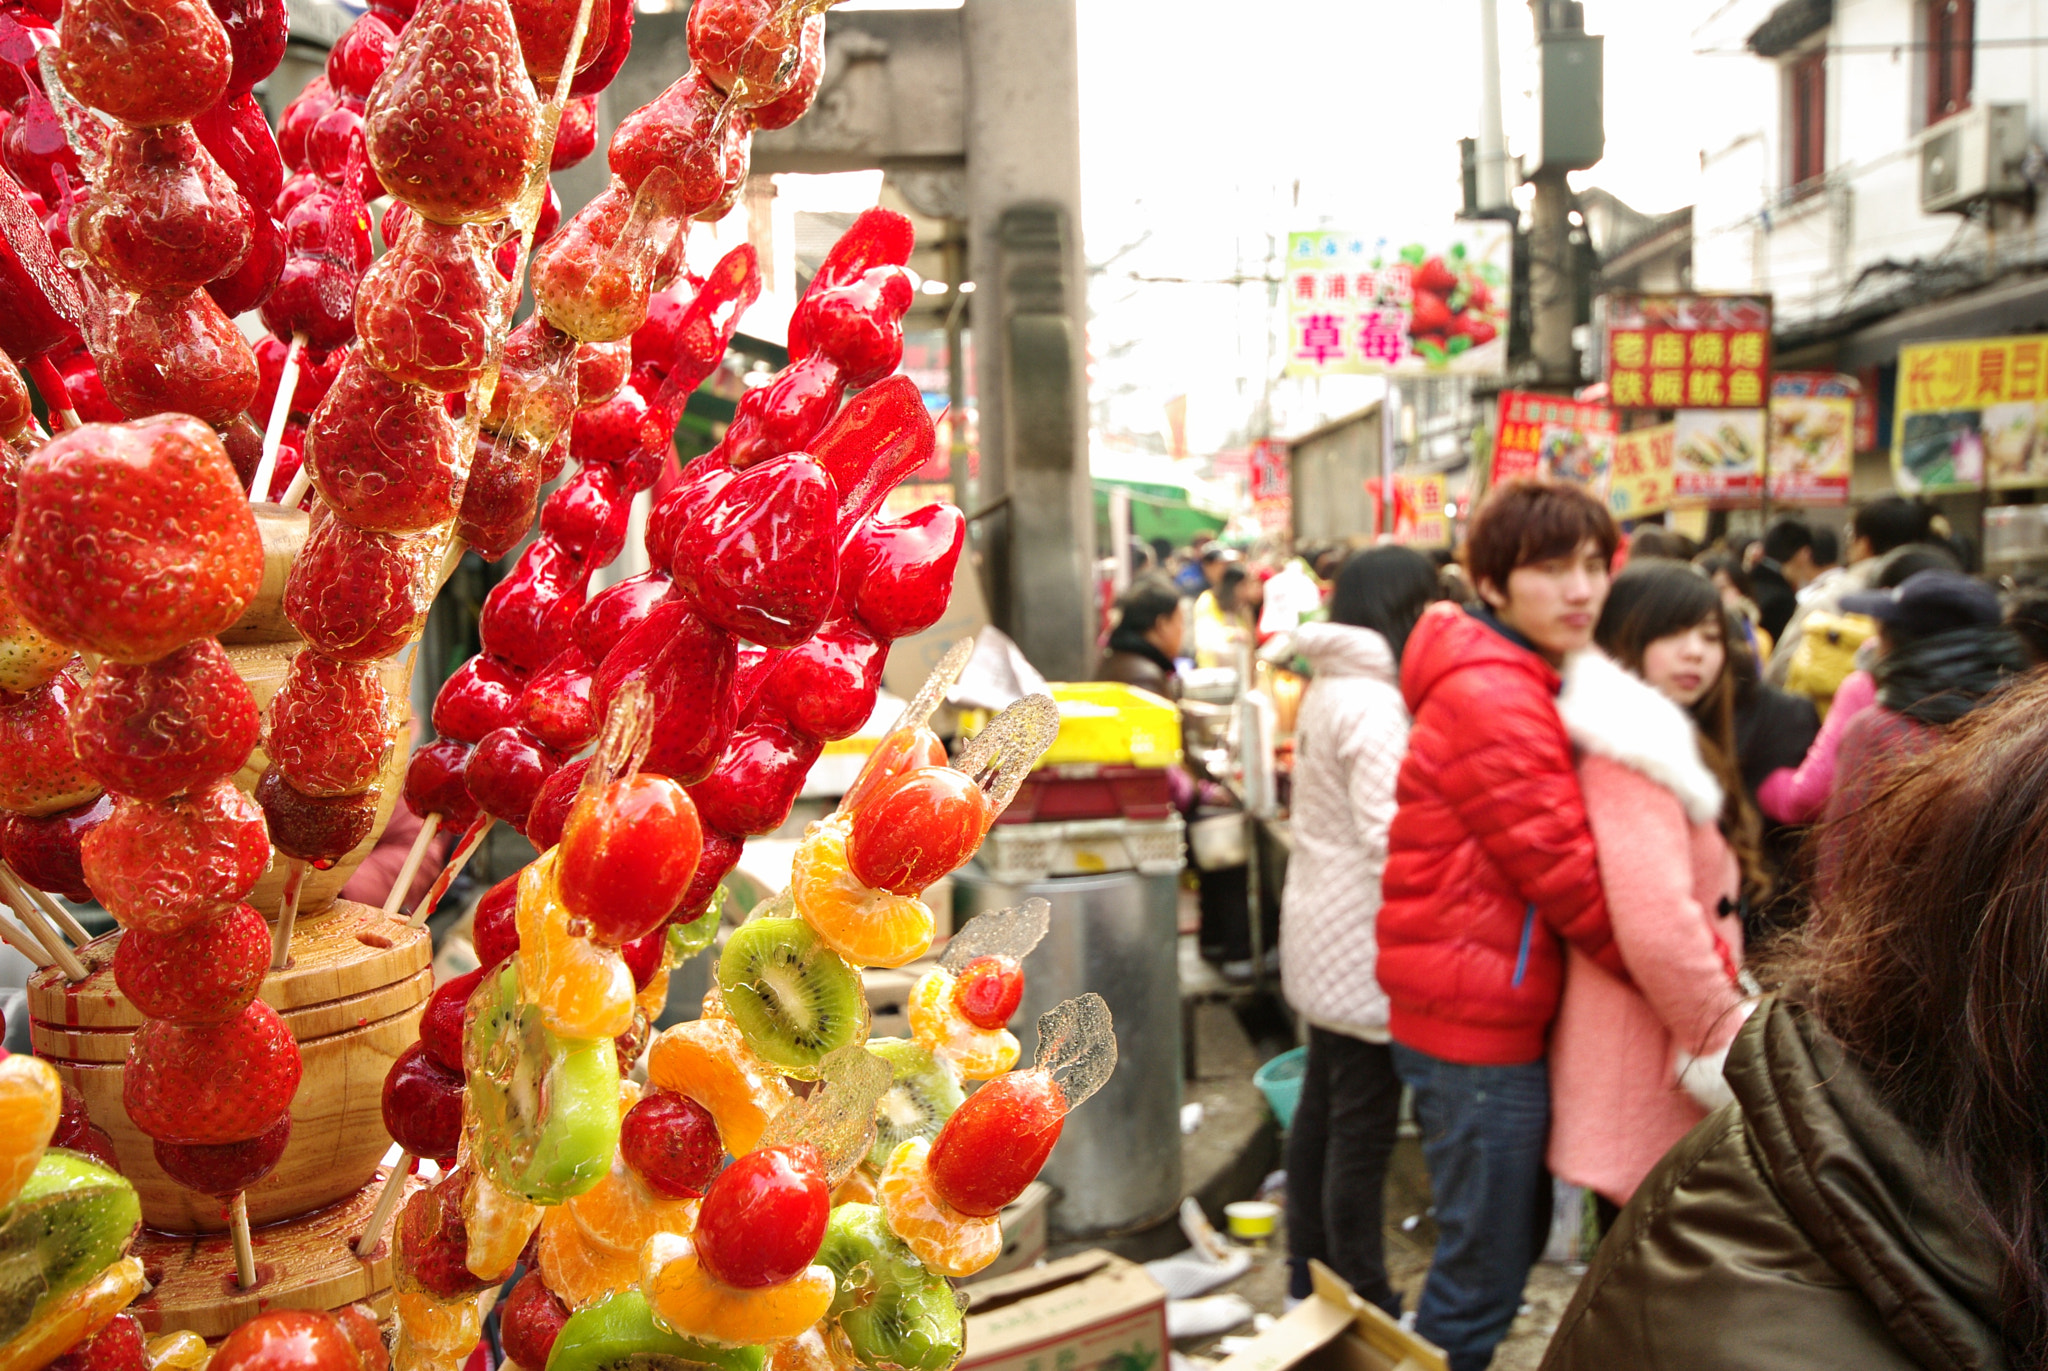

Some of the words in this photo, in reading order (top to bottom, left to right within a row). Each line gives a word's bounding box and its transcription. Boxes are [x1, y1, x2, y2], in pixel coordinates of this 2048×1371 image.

[1297, 313, 1403, 365] 草莓
[1613, 332, 1766, 368] 老庙烧烤
[1611, 370, 1762, 406] 铁板鱿鱼
[1909, 343, 2048, 408] 长沙臭豆
